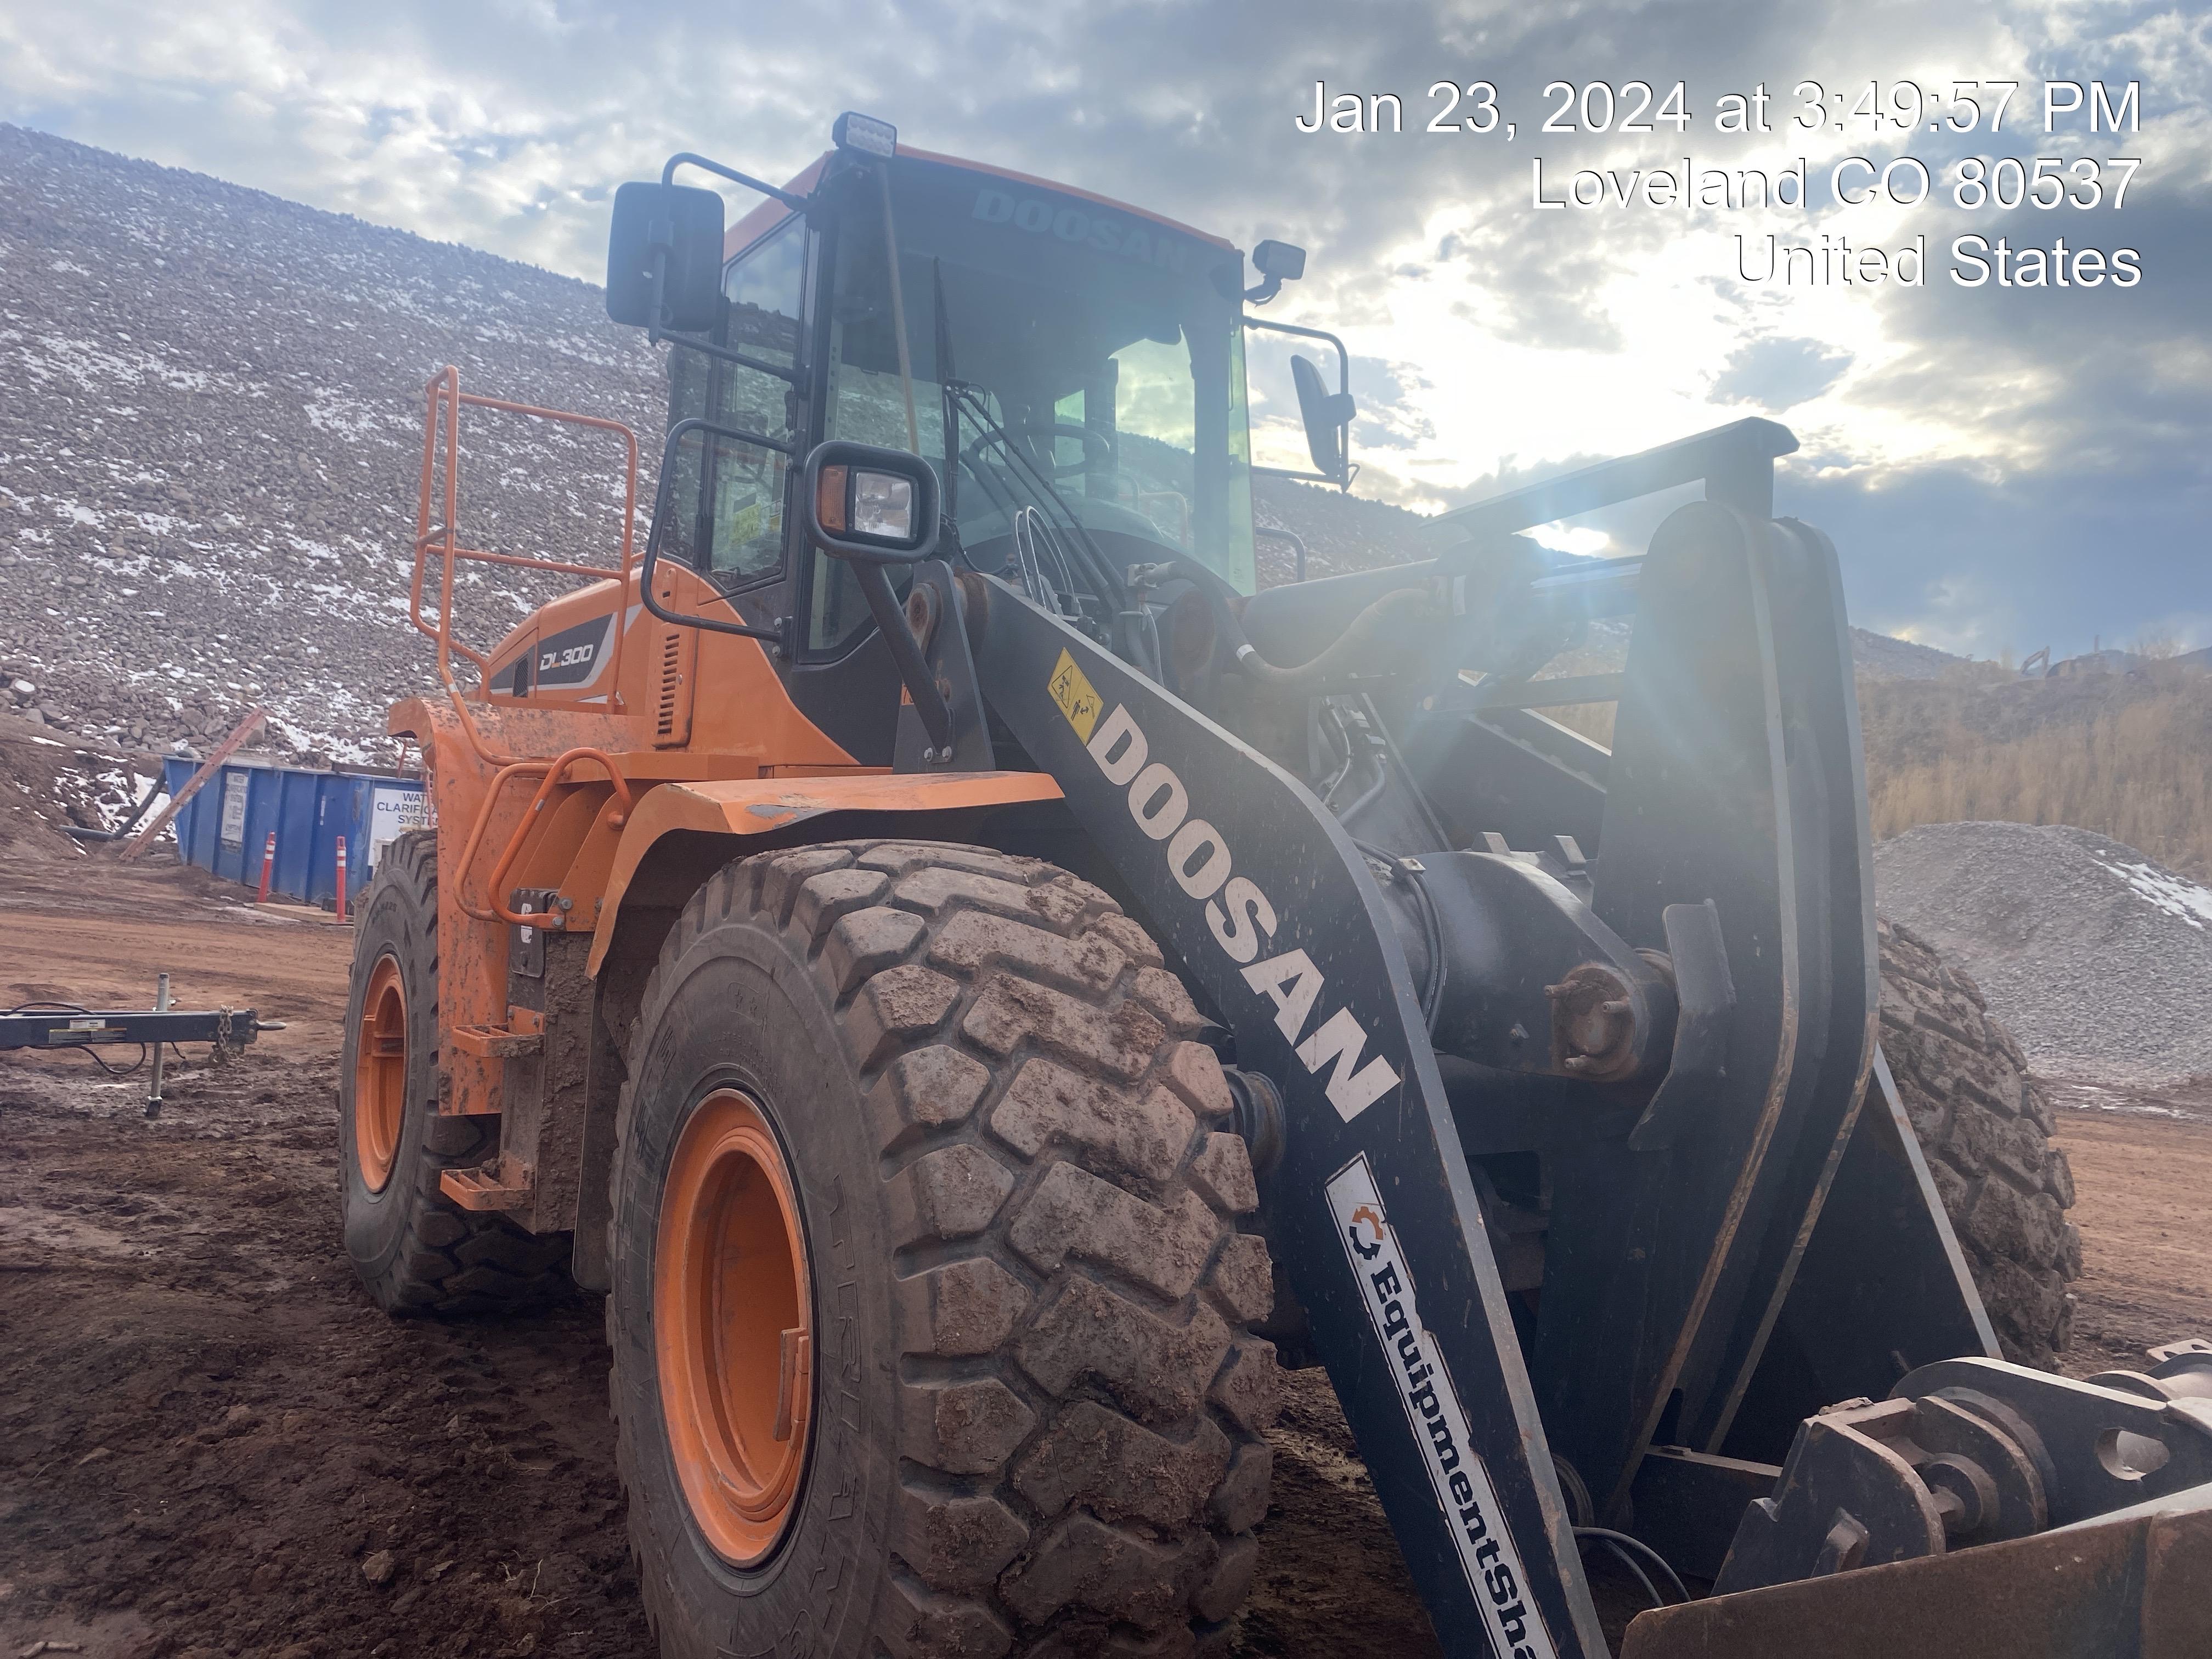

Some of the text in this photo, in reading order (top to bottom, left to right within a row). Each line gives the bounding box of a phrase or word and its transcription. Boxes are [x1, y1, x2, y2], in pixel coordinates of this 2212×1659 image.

[971, 189, 1188, 273] DOOSAN
[540, 644, 594, 670] DL300
[1087, 703, 1401, 1123] DOOSAN
